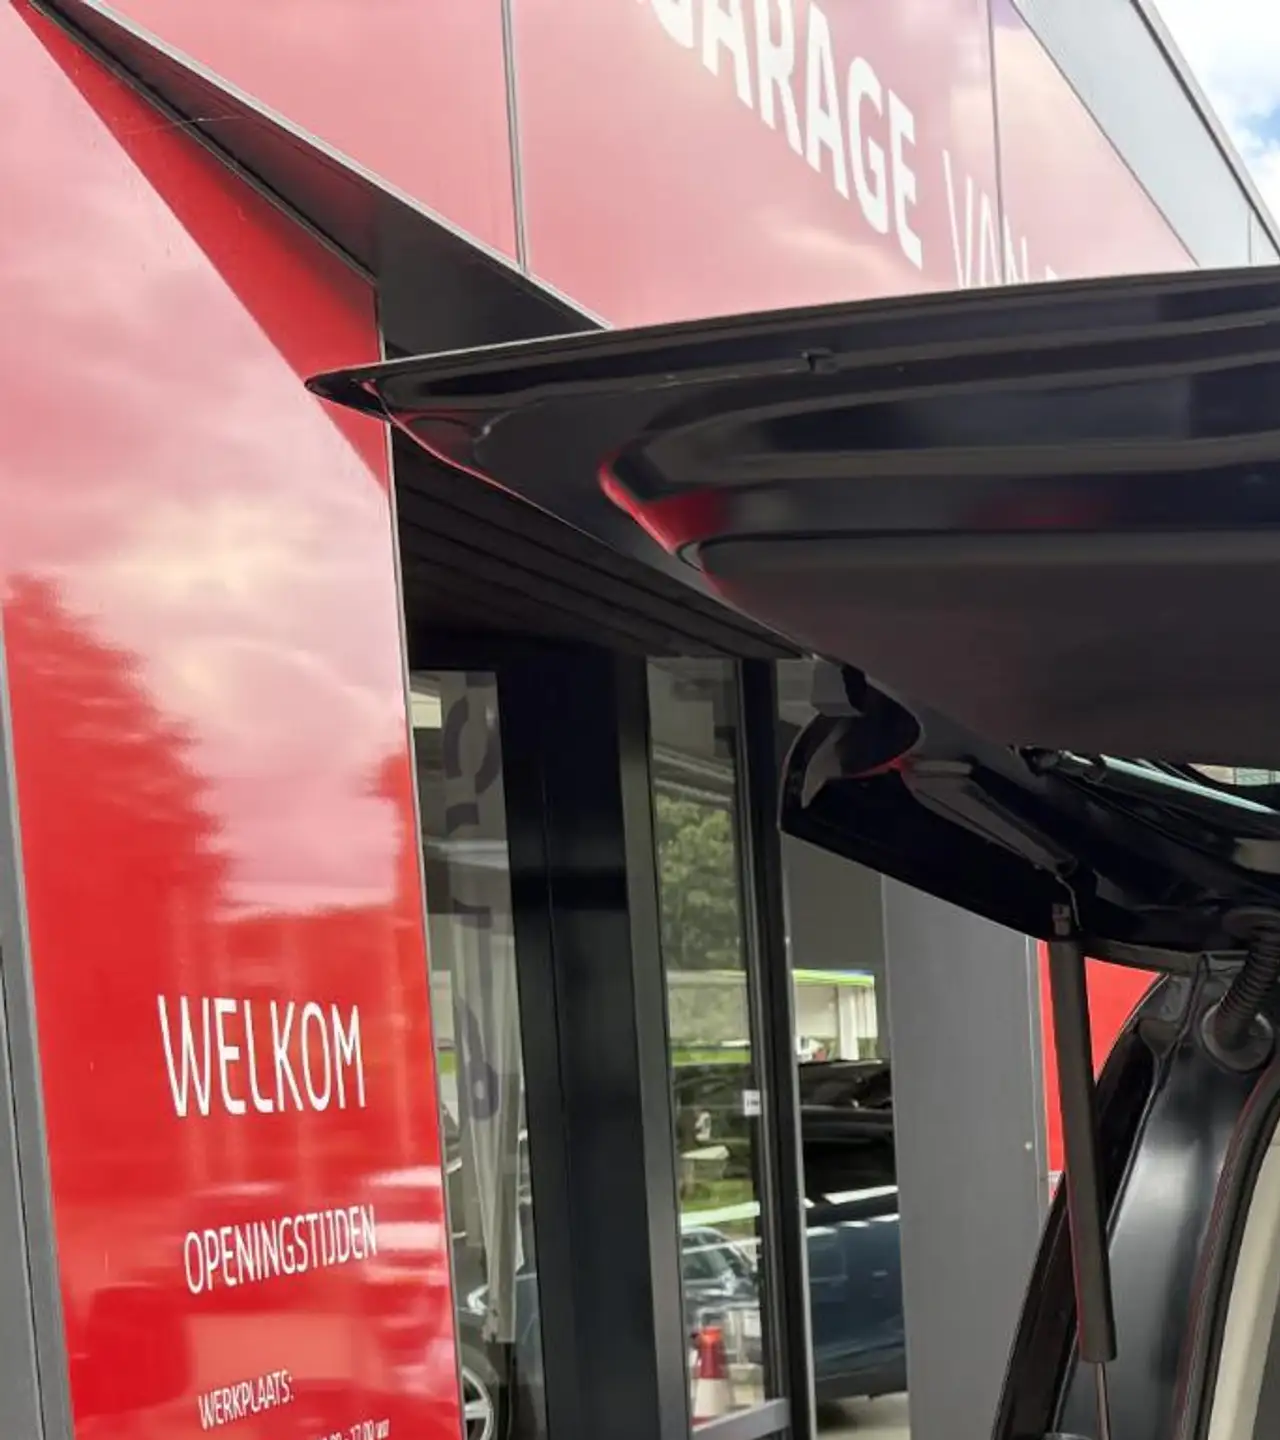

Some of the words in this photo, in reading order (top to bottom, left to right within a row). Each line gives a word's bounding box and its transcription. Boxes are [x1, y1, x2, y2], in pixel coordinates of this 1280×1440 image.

[157, 994, 366, 1118] WELKOM
[184, 1204, 378, 1294] OPENINGSTIJDEN
[198, 1369, 294, 1431] WERKPLAATS:
